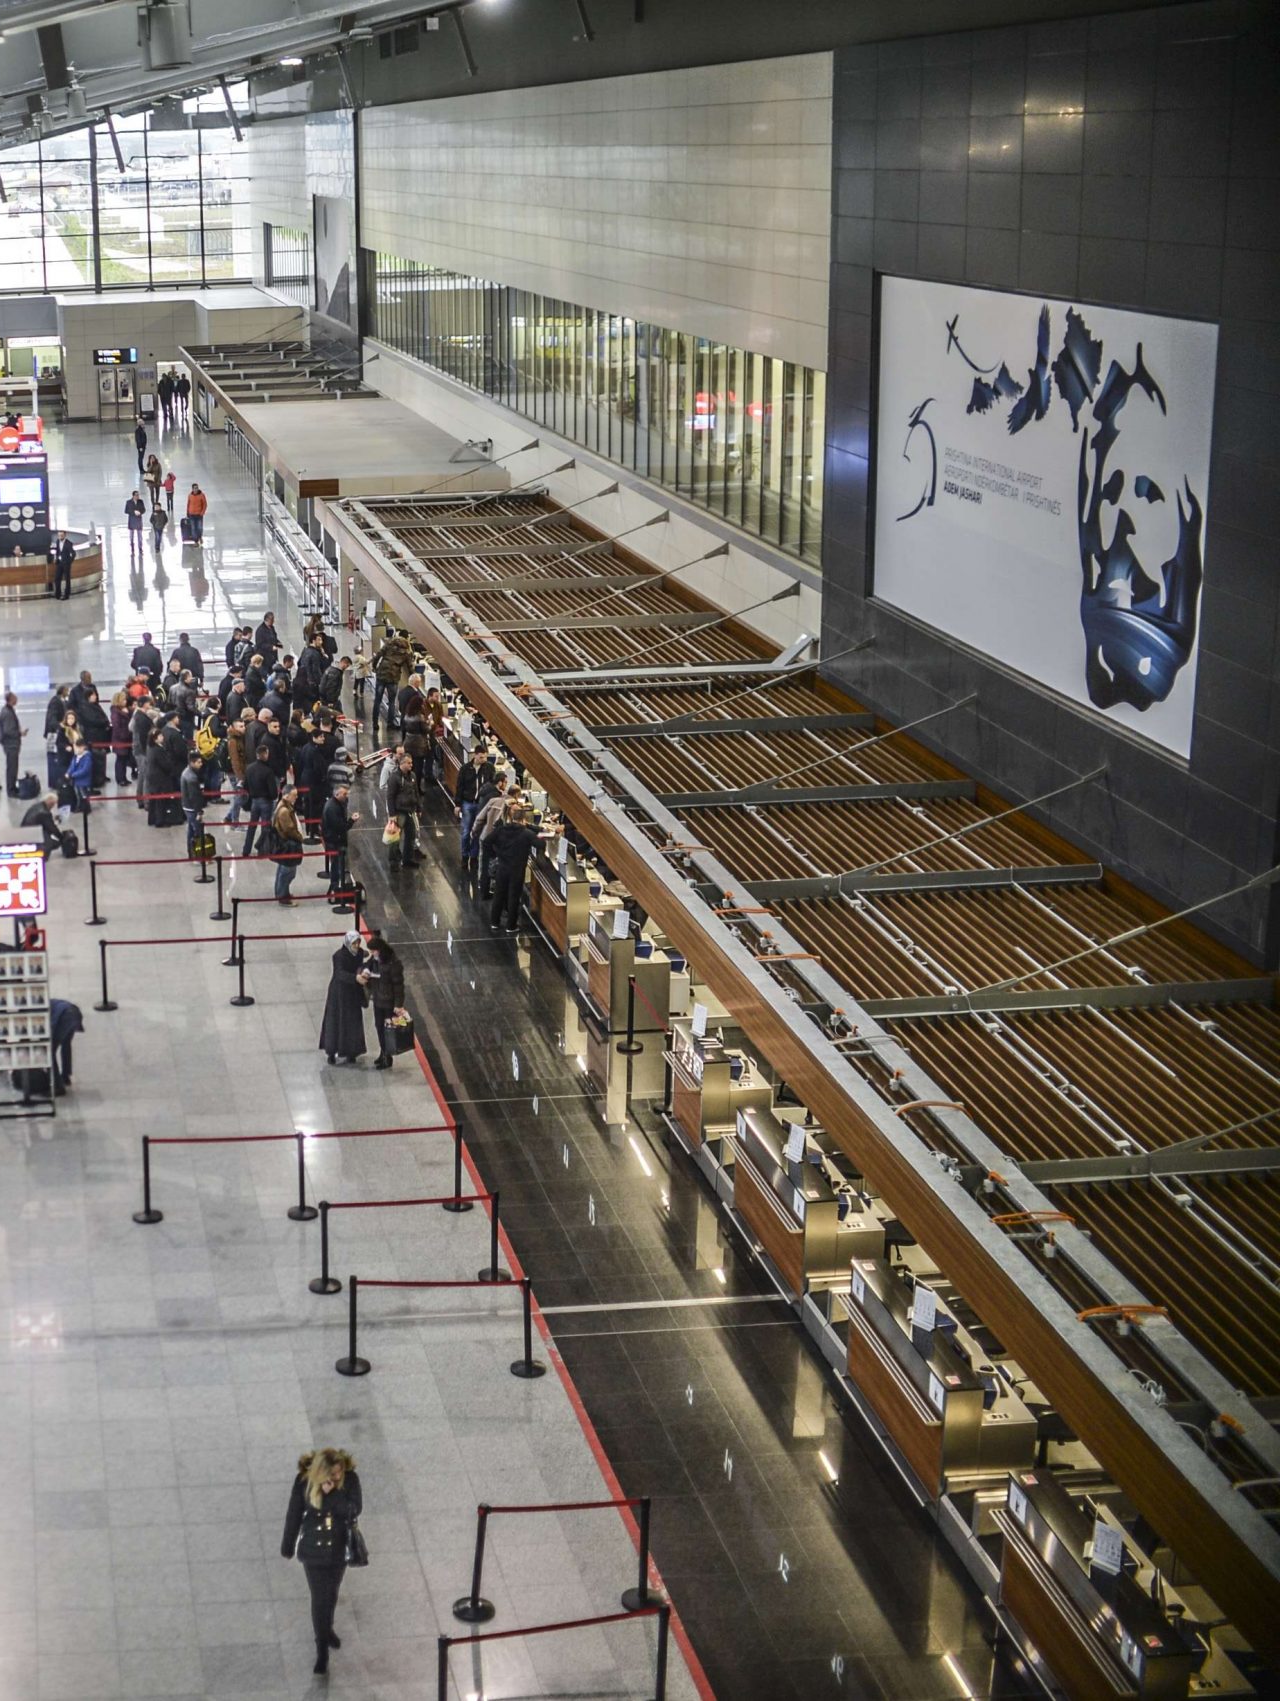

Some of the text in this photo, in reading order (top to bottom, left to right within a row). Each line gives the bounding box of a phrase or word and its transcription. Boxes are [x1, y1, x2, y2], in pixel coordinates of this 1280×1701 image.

[944, 446, 1043, 490] PRISHTINA INTERNATIONAL AIRPORT
[944, 480, 982, 504] ADEM JASHARI
